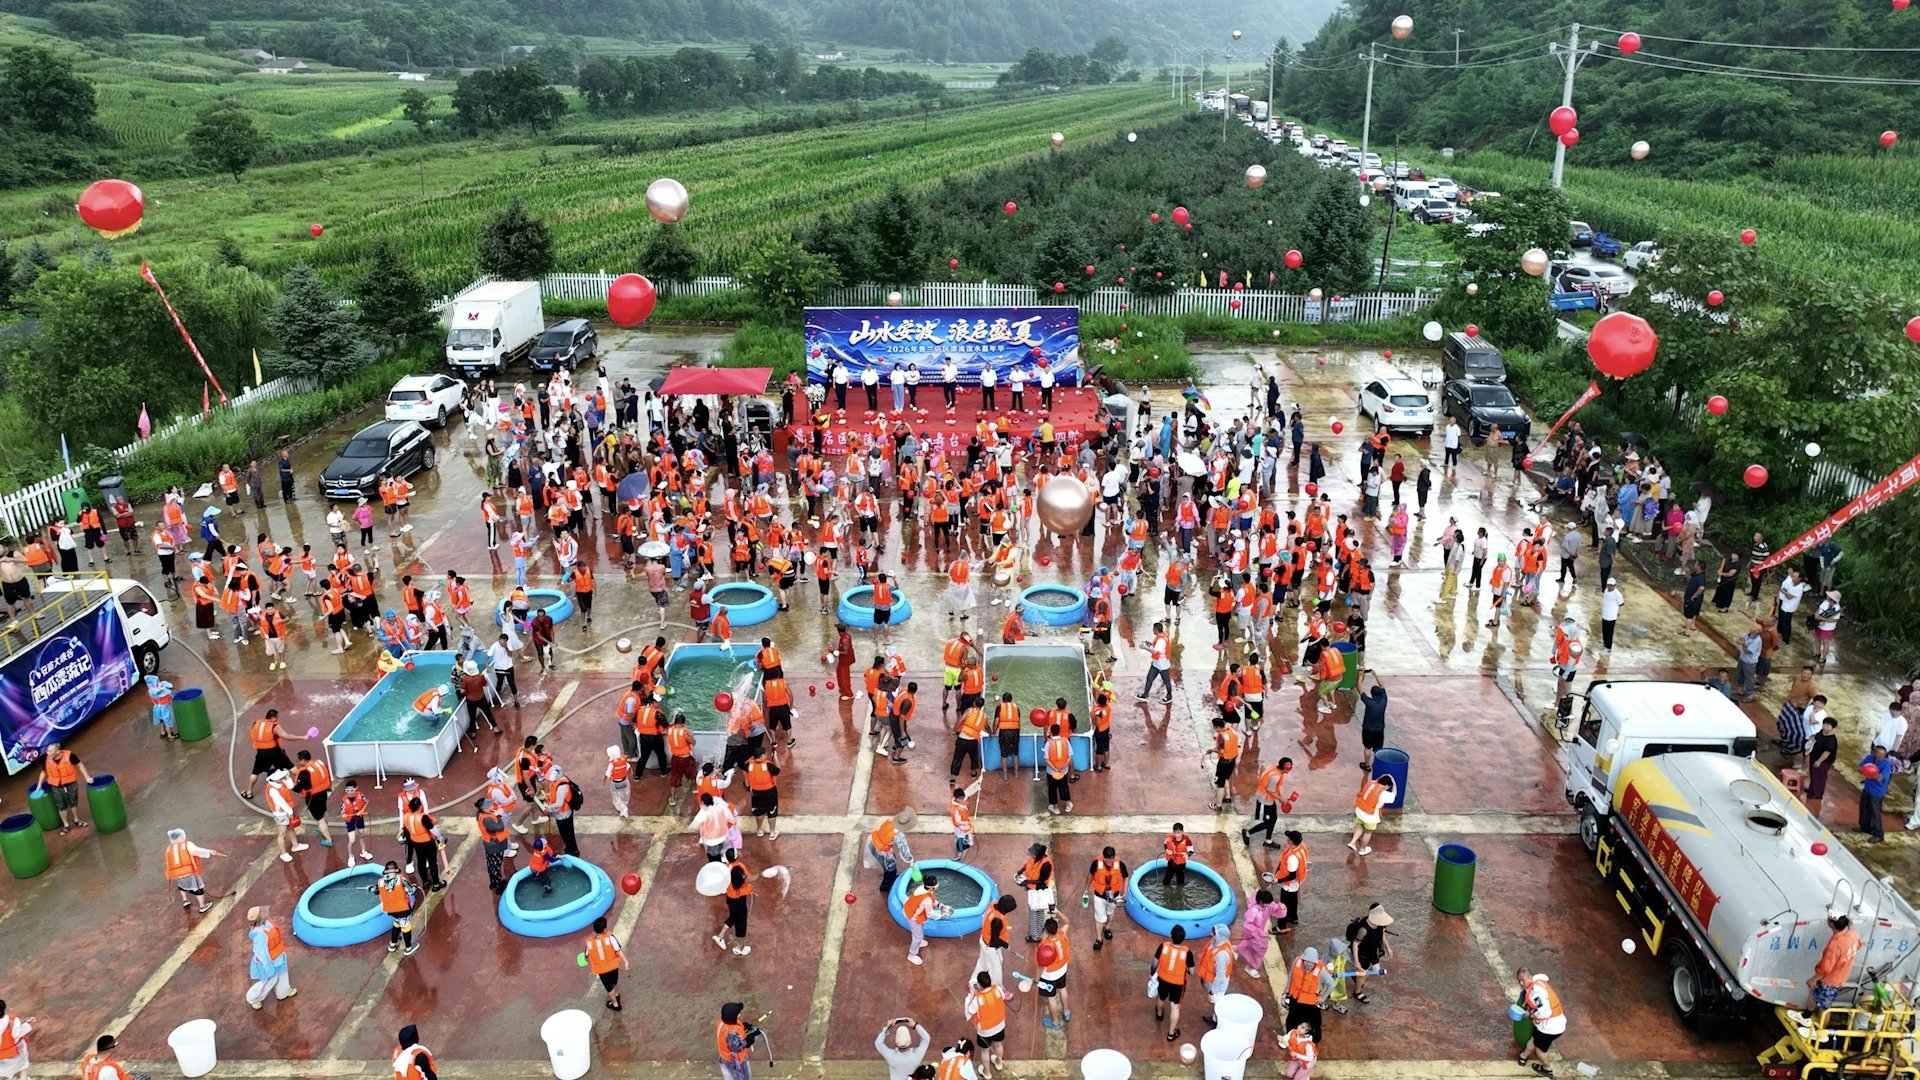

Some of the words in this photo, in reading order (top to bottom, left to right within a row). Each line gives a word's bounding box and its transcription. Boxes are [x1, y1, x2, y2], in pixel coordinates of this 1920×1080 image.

[849, 319, 945, 346] 山水安波
[32, 653, 92, 705] 西瓜漂流记
